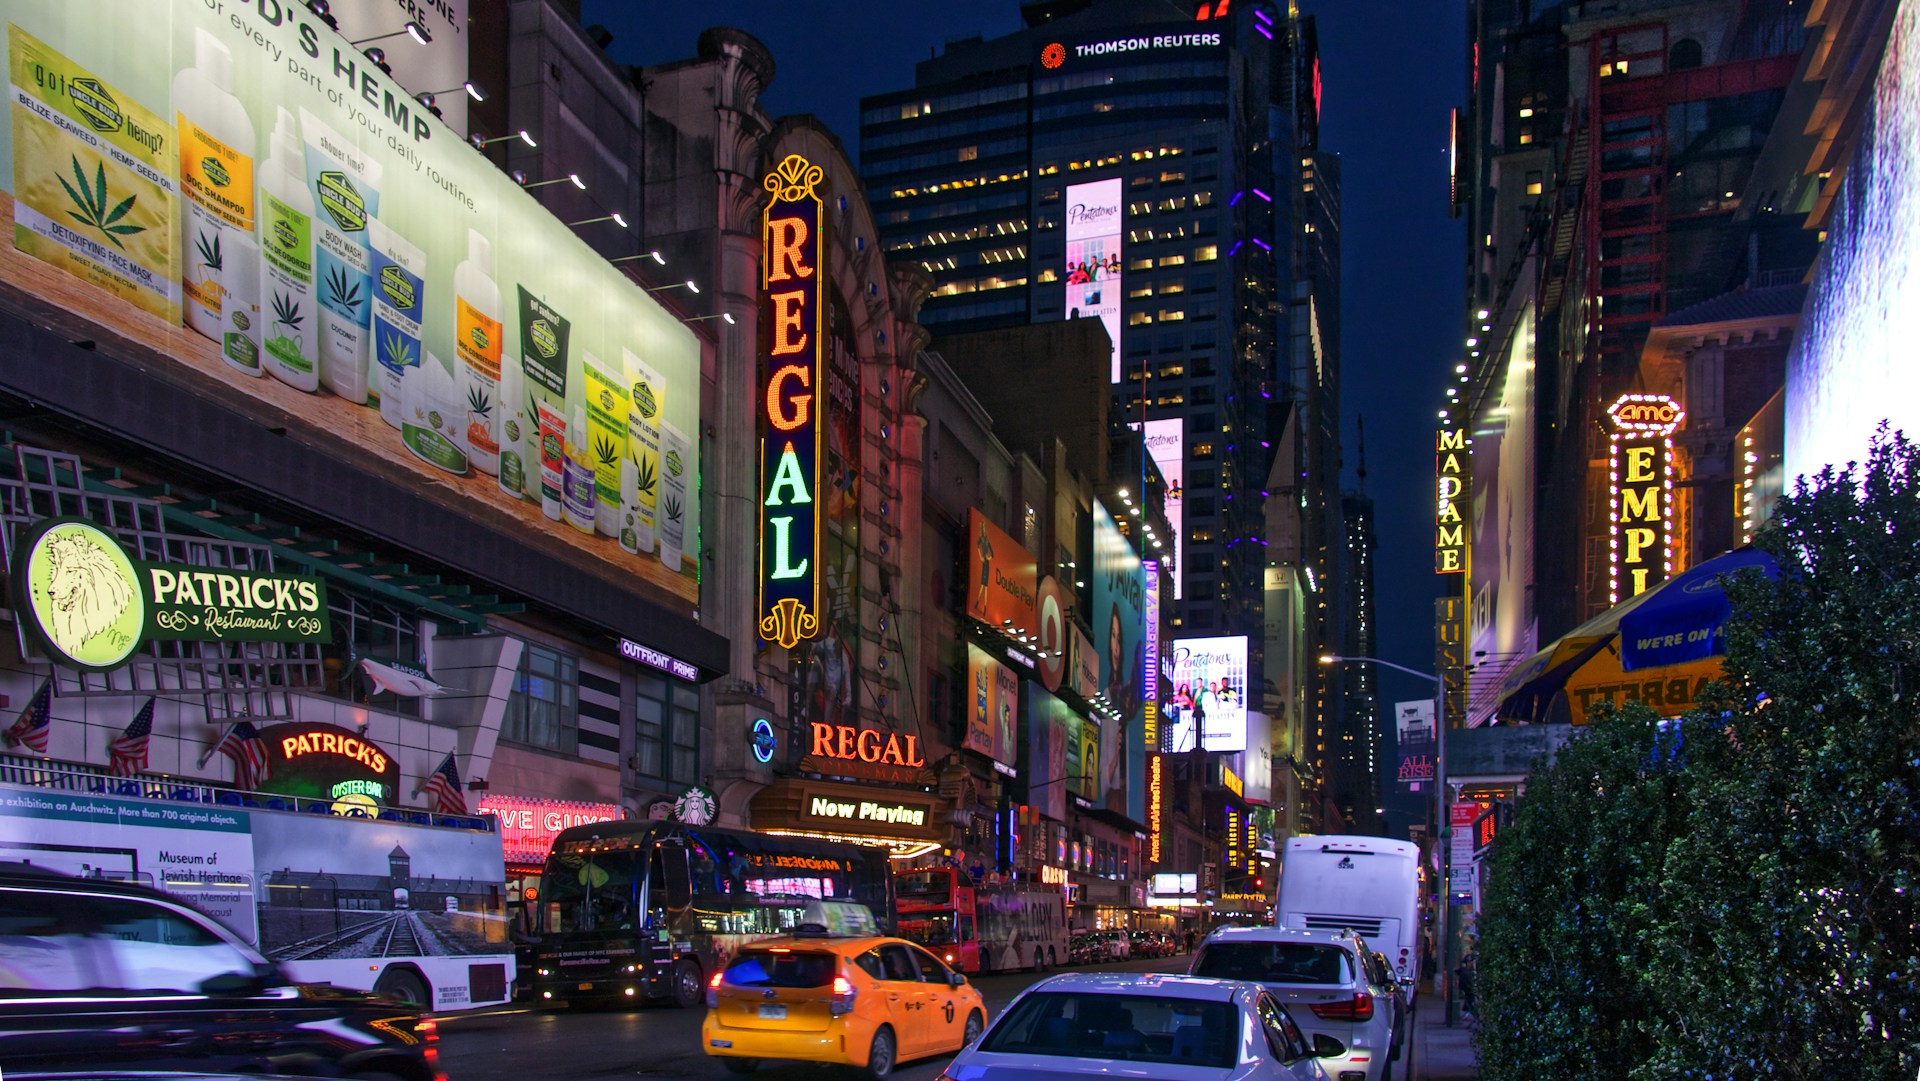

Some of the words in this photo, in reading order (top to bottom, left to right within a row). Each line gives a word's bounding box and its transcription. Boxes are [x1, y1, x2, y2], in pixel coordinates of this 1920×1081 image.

[1075, 37, 1149, 57] THOMSON
[1153, 33, 1220, 48] REUTERS
[36, 64, 65, 96] got
[240, 0, 318, 59] D'S
[333, 47, 430, 142] HEMP
[70, 87, 97, 109] UNCLE
[99, 101, 122, 126] BUD'S
[231, 14, 282, 61] every
[289, 60, 321, 93] part
[328, 88, 343, 106] of
[349, 105, 383, 138] your
[387, 133, 423, 172] daily
[426, 165, 478, 213] routine.
[19, 93, 51, 120] BELIZE
[54, 115, 97, 146] SEAWEED
[110, 149, 134, 168] HEMP
[137, 164, 158, 182] SEED
[160, 177, 173, 192] OIL
[126, 115, 164, 156] hemp?
[320, 136, 345, 161] shower
[347, 153, 365, 175] time?
[186, 173, 203, 191] DOG
[204, 186, 245, 215] SHAMPOO
[319, 183, 344, 207] UNCLE
[344, 199, 367, 224] BUD'S
[206, 201, 222, 216] HEMP
[222, 211, 236, 224] SEED
[1069, 204, 1117, 224] Pentatonix
[52, 222, 107, 260] DETOXIFYING
[108, 250, 128, 270] FACE
[130, 262, 153, 283] MASK
[325, 229, 343, 247] BODY
[343, 241, 362, 259] WASH
[332, 246, 347, 259] HEMP
[69, 252, 90, 269] SWEET
[92, 262, 111, 279] AGAVE
[113, 273, 137, 291] NECTAR
[331, 323, 357, 343] COCONUT
[406, 319, 419, 331] CREAM
[765, 217, 814, 579] REGAL
[629, 413, 642, 427] BODY
[642, 422, 659, 440] LOTION
[1438, 428, 1465, 571] MADAME
[1620, 446, 1662, 597] EMPI
[150, 568, 319, 612] PATRICK'S
[995, 567, 1020, 596] Double
[1020, 586, 1035, 611] Play
[204, 607, 287, 638] Restaurant
[1637, 629, 1683, 650] WE'RE
[1688, 627, 1709, 643] ON
[391, 662, 425, 678] SEAFOOD
[623, 641, 670, 669] OUTFRONT
[673, 662, 695, 679] PRIME
[1173, 647, 1232, 672] Pentatonix
[996, 666, 1017, 696] Monet
[811, 722, 924, 768] REGAL
[970, 720, 993, 750] Partay
[282, 732, 387, 774] PATRICK'S
[1402, 755, 1431, 767] ALL
[822, 760, 914, 783] CINEMAS
[1399, 766, 1434, 778] RISE
[332, 780, 365, 798] OYSTER
[365, 780, 382, 799] BAR
[7, 798, 53, 811] exhibition
[56, 803, 68, 811] on
[70, 802, 116, 816] Auschwitz.
[119, 806, 140, 817] More
[142, 808, 161, 819] than
[162, 810, 178, 820] 700
[179, 812, 209, 824] original
[210, 814, 238, 826] objects.
[476, 807, 533, 829] VE
[811, 798, 856, 819] Now
[859, 802, 924, 826] Playing
[1228, 812, 1238, 847] VICTORY
[159, 851, 203, 865] Museum
[207, 851, 217, 865] of
[160, 869, 195, 883] Jewish
[199, 870, 242, 885] Heritage
[201, 892, 240, 903] Memorial
